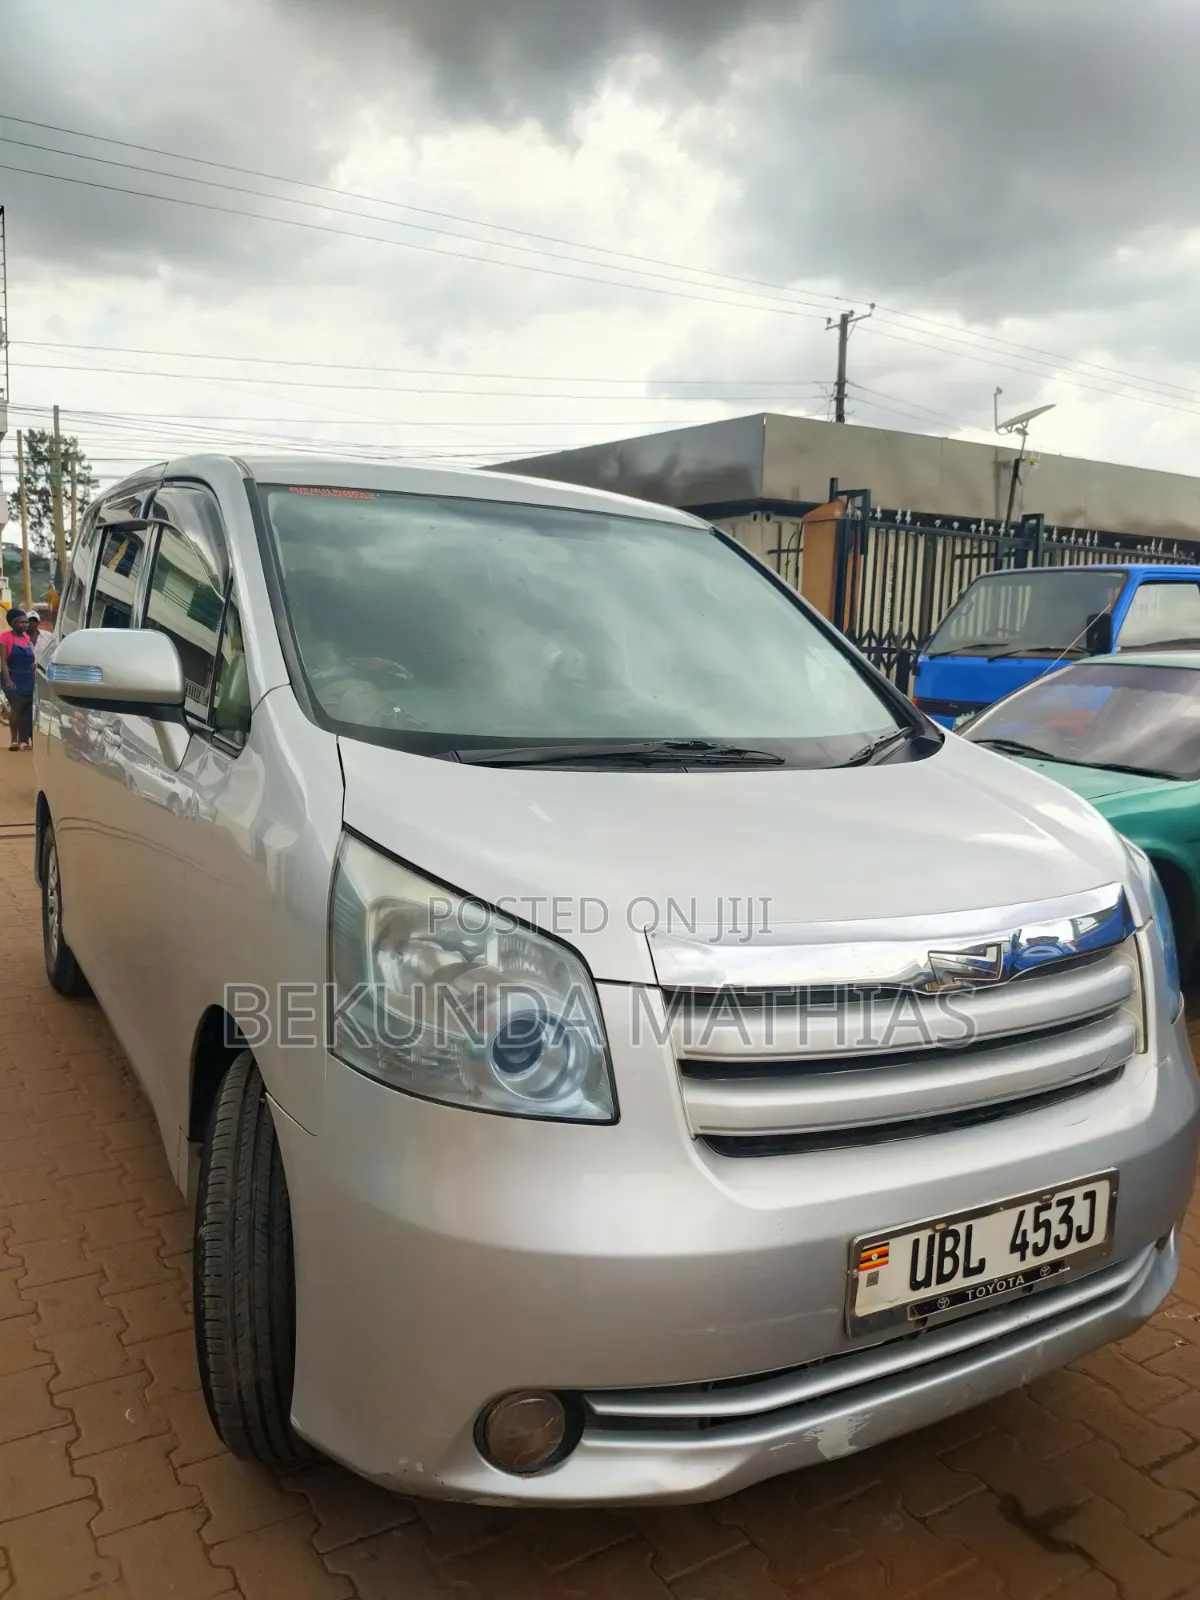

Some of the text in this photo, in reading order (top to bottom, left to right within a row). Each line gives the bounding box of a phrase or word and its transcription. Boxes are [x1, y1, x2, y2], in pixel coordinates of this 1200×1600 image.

[909, 1190, 1097, 1291] UBL 453J
[966, 1275, 1025, 1300] TOYOTA
